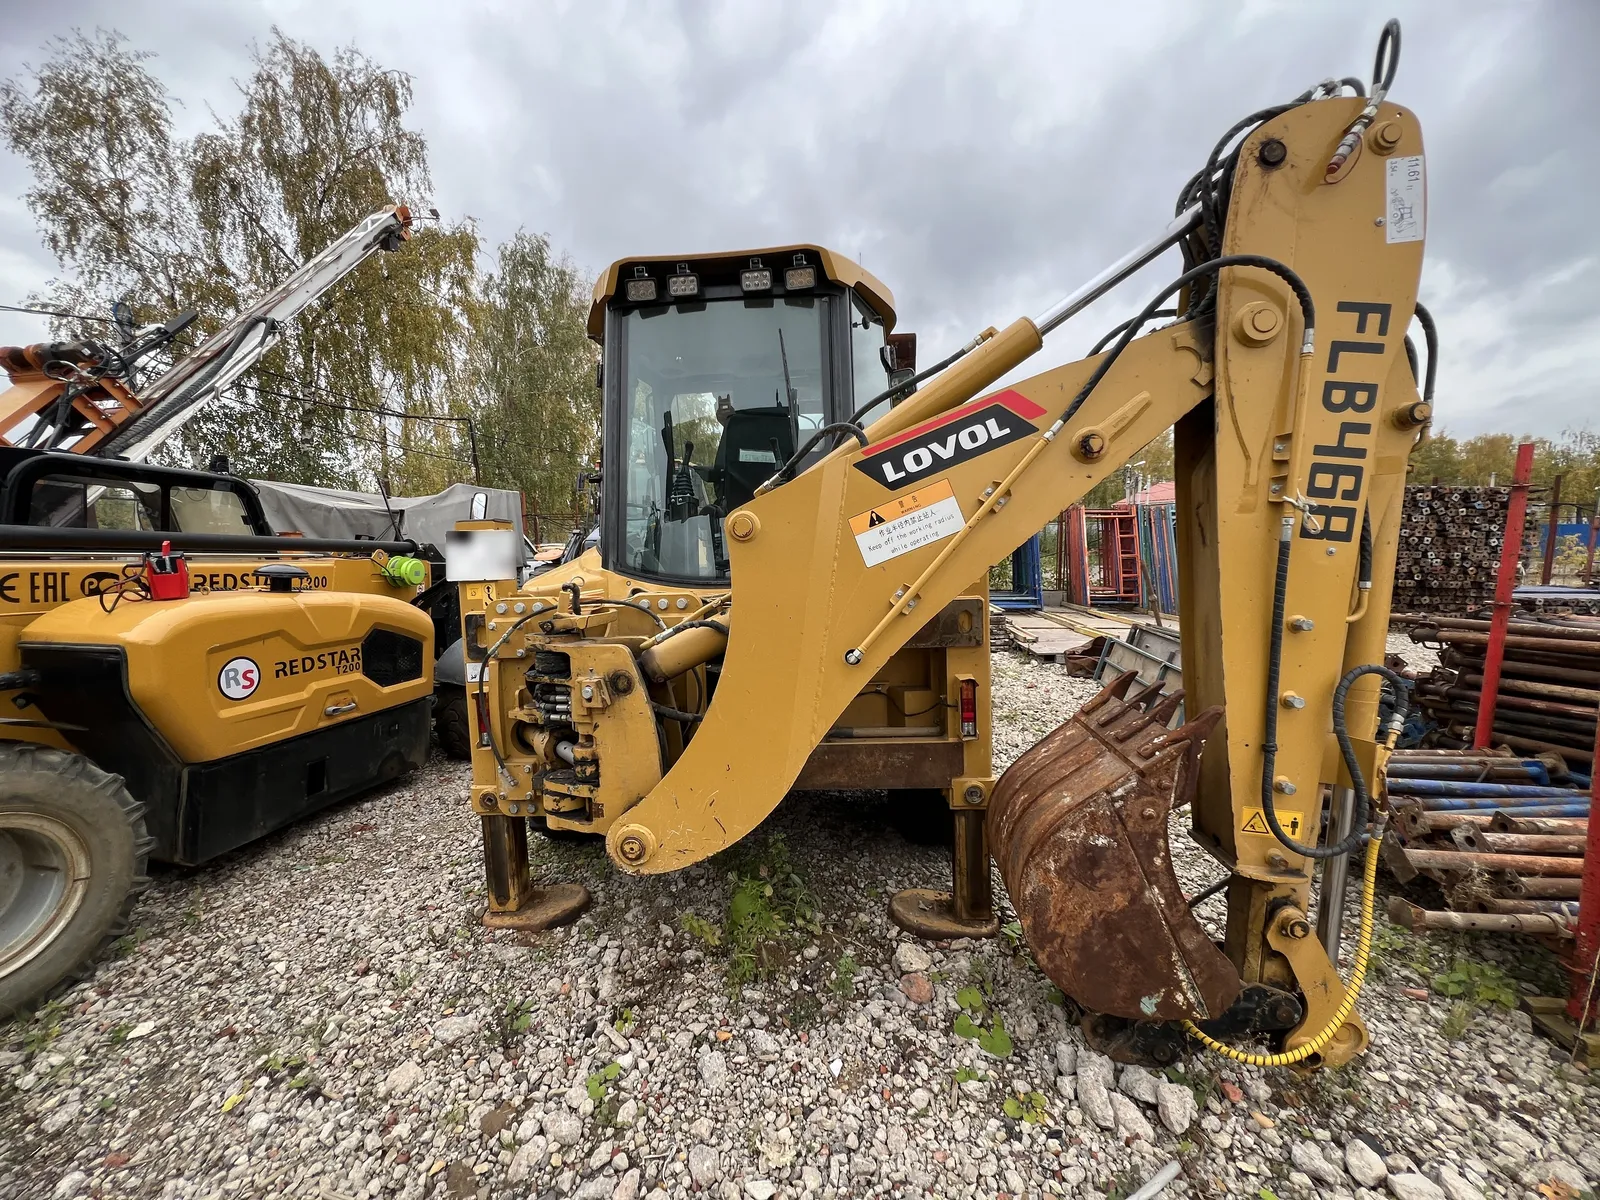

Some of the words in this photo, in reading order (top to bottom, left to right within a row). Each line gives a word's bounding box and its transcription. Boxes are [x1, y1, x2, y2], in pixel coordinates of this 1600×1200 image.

[1299, 301, 1392, 543] FLB468
[882, 417, 1011, 483] LOVOL
[868, 543, 883, 552] Keep
[884, 536, 894, 546] off
[896, 532, 908, 541] the
[909, 522, 933, 537] working
[934, 513, 955, 526] radius
[891, 543, 908, 554] while
[909, 531, 940, 547] operating
[30, 572, 70, 603] EAC
[224, 667, 255, 690] RS
[274, 647, 361, 679] REDSTAR
[336, 662, 361, 675] T200
